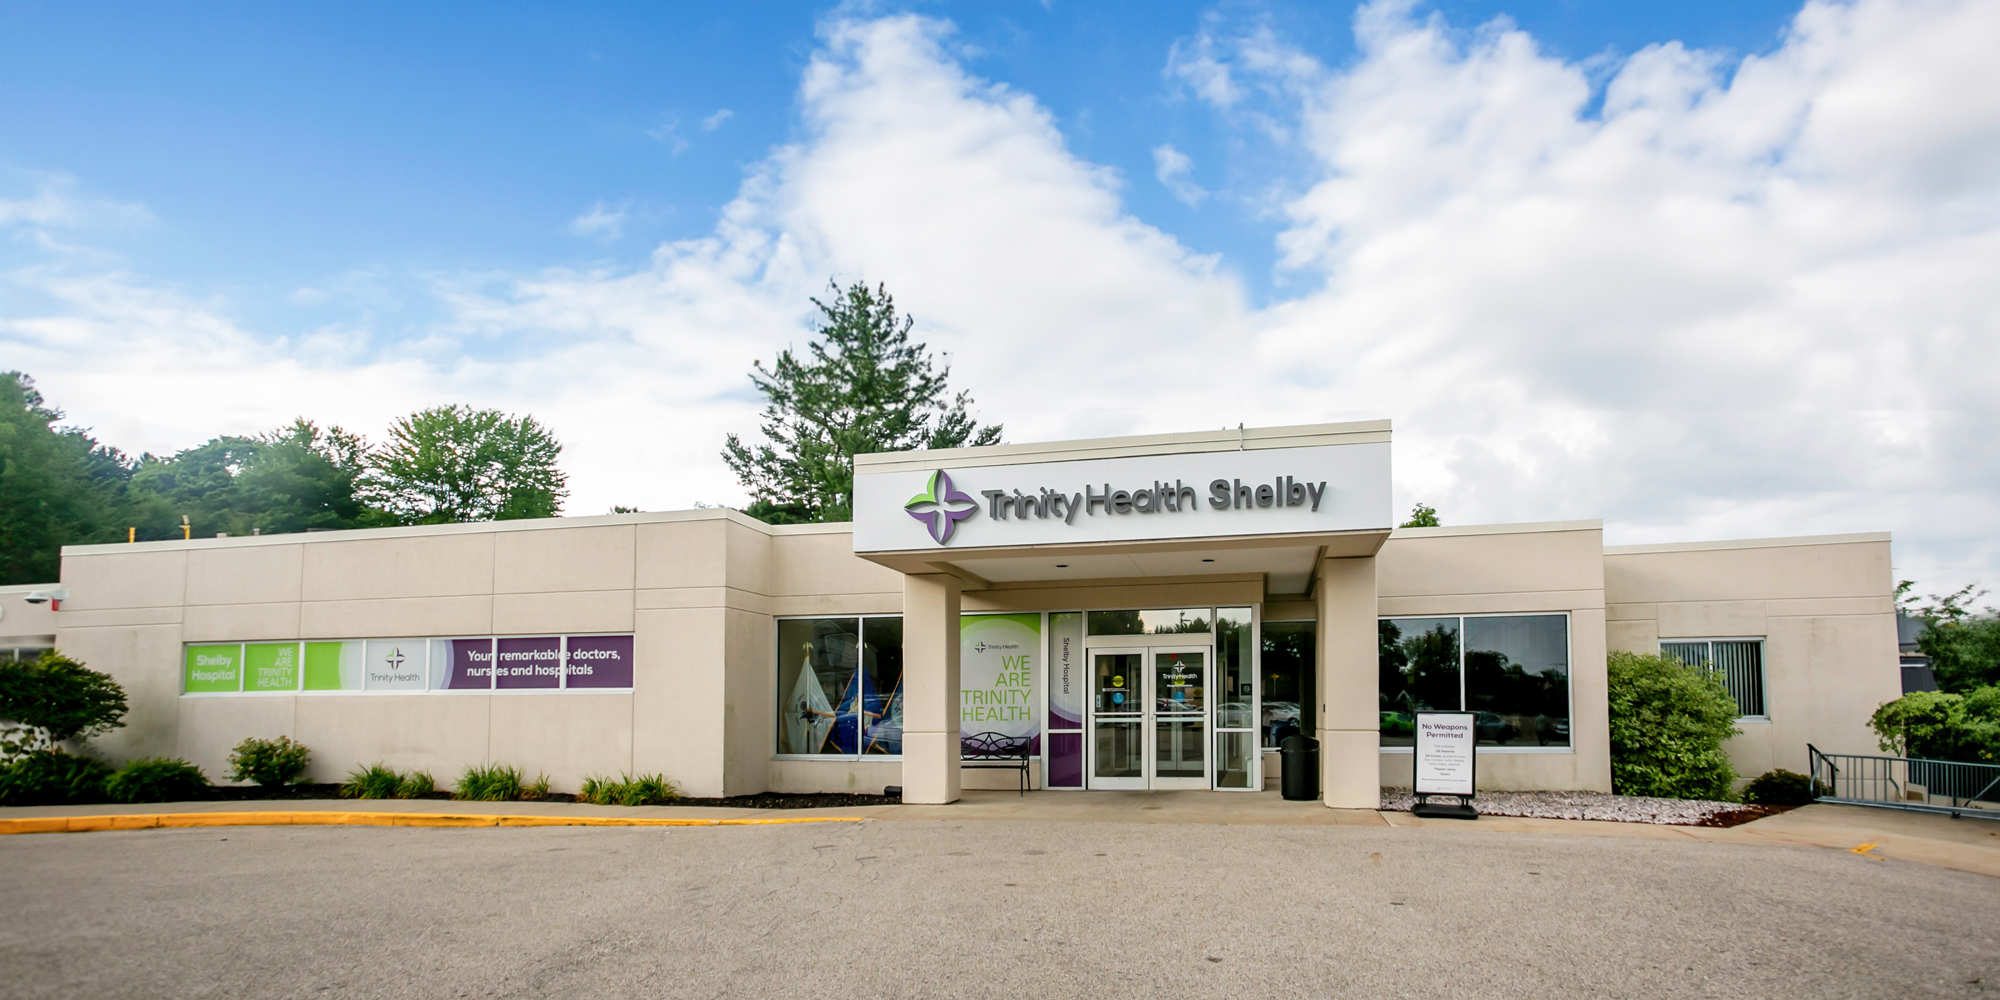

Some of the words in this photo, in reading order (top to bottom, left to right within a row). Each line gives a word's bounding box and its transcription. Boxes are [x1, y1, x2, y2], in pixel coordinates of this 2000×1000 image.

[981, 487, 1083, 525] Trinity
[1086, 479, 1196, 515] Health
[1208, 475, 1327, 512] Shelby
[278, 647, 293, 657] WE
[467, 650, 493, 662] Your
[500, 649, 571, 661] remarkable
[573, 648, 621, 661] doctors,
[1062, 637, 1070, 662] Shelby
[196, 654, 233, 668] Shelby
[274, 657, 293, 667] ARE
[1002, 655, 1031, 670] WE
[191, 669, 236, 684] Hospital
[258, 667, 293, 677] TRINITY
[467, 666, 509, 677] nurses
[511, 665, 533, 676] and
[257, 677, 292, 687] HEALTH
[371, 673, 393, 684] Trinity
[394, 673, 420, 682] Health
[995, 672, 1031, 687] ARE
[1062, 664, 1070, 694] Hospital
[961, 689, 1031, 705] TRINITY
[962, 706, 1031, 721] HEALTH
[1433, 723, 1468, 731] Weapons
